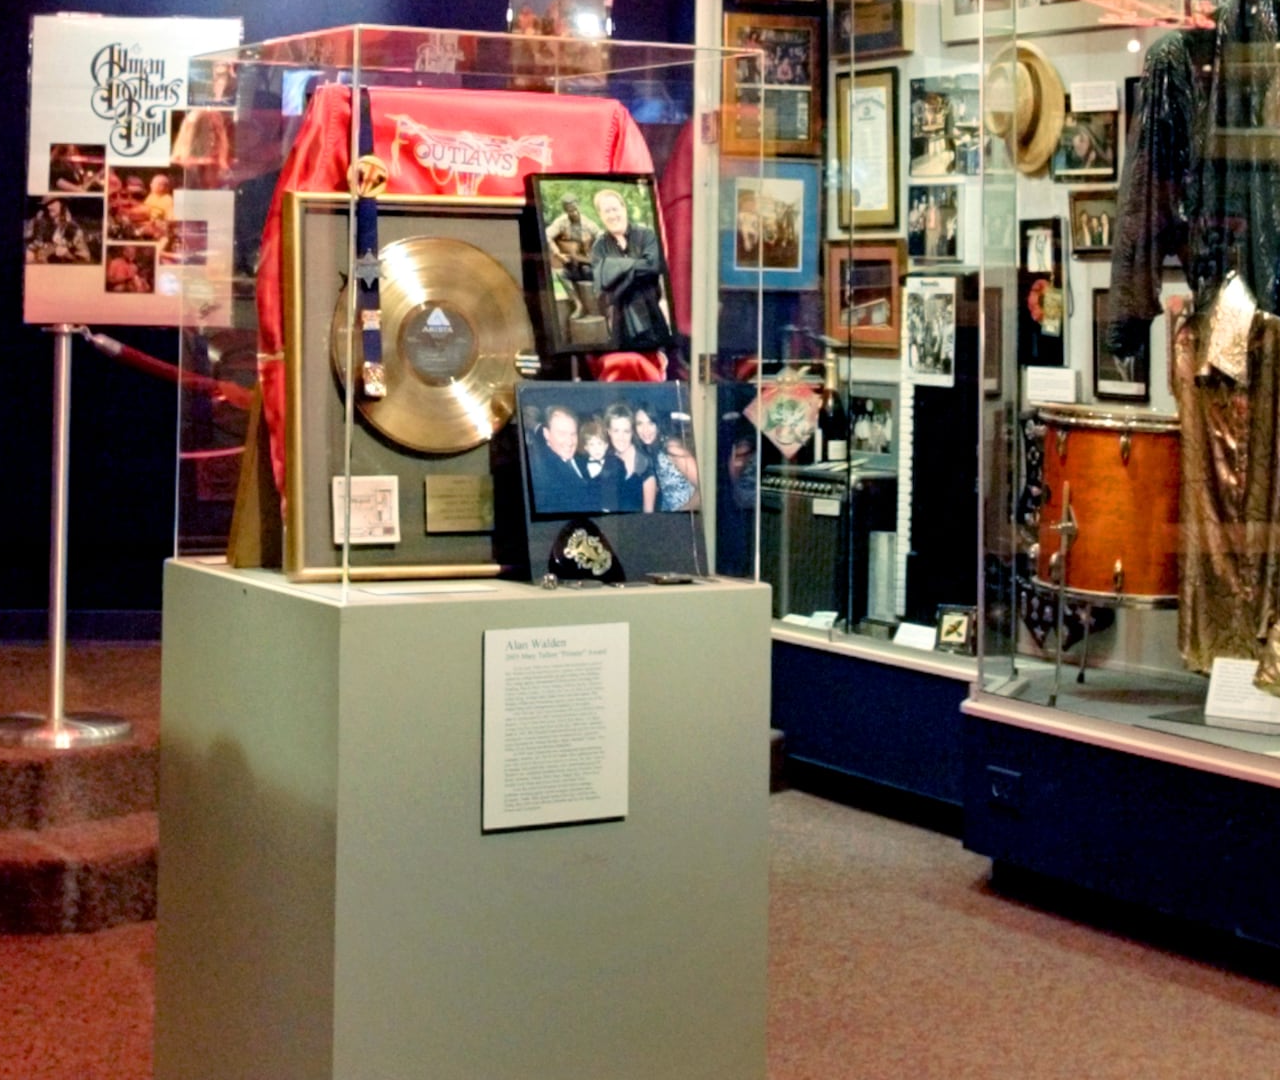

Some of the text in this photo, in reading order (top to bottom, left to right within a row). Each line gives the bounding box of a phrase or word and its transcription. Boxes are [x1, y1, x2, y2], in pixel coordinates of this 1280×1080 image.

[90, 42, 166, 87] Allman
[91, 77, 183, 121] Brothers
[109, 98, 166, 158] Band
[415, 142, 514, 172] OUTLAWS
[505, 637, 567, 651] Alan Walden
